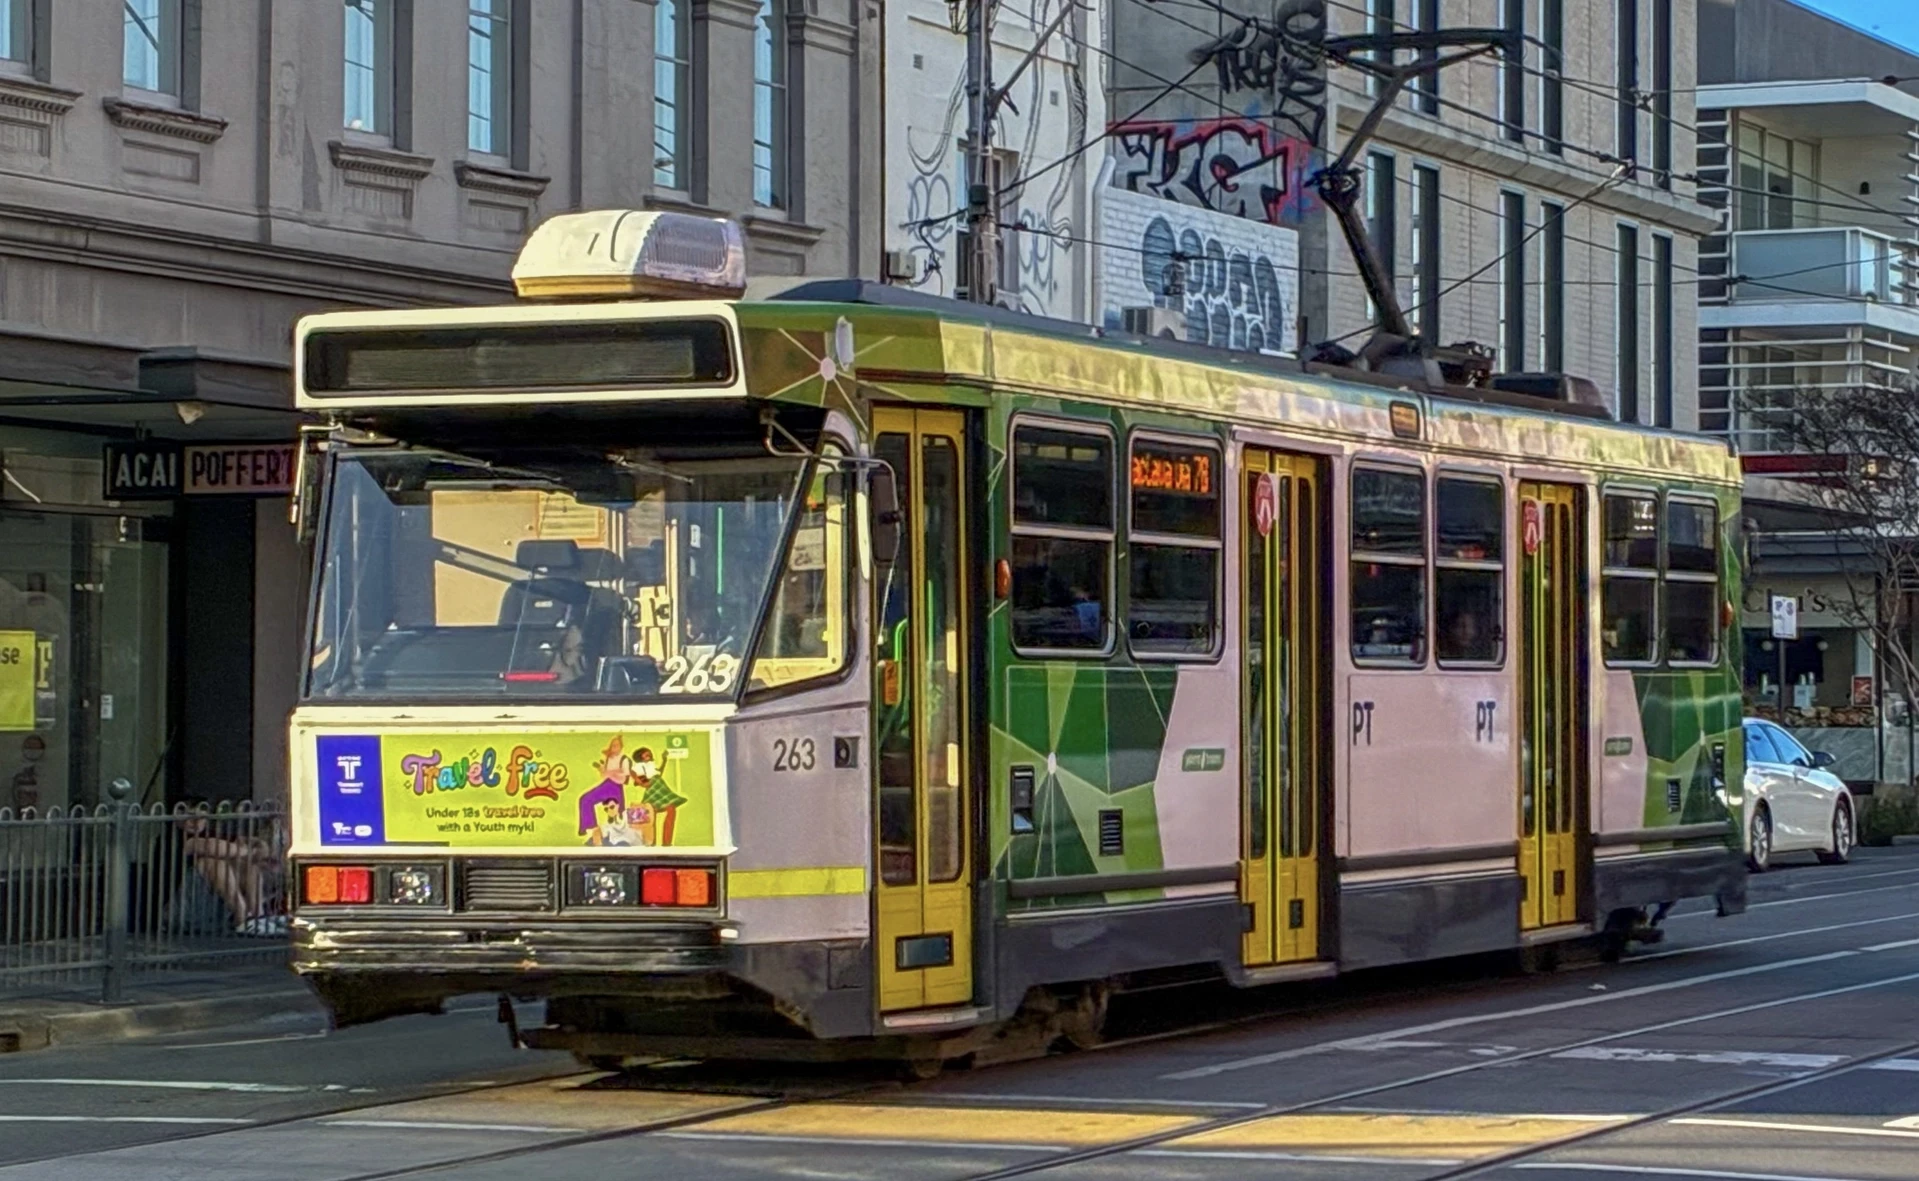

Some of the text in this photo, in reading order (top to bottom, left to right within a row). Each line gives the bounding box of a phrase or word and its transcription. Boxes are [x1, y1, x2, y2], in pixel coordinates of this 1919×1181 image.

[115, 452, 177, 487] ACAI
[659, 653, 734, 693] 263
[401, 745, 570, 796] Travel free
[773, 738, 816, 772] 263
[426, 806, 546, 818] Under 18s travel free
[437, 822, 535, 835] with a Youth myki
